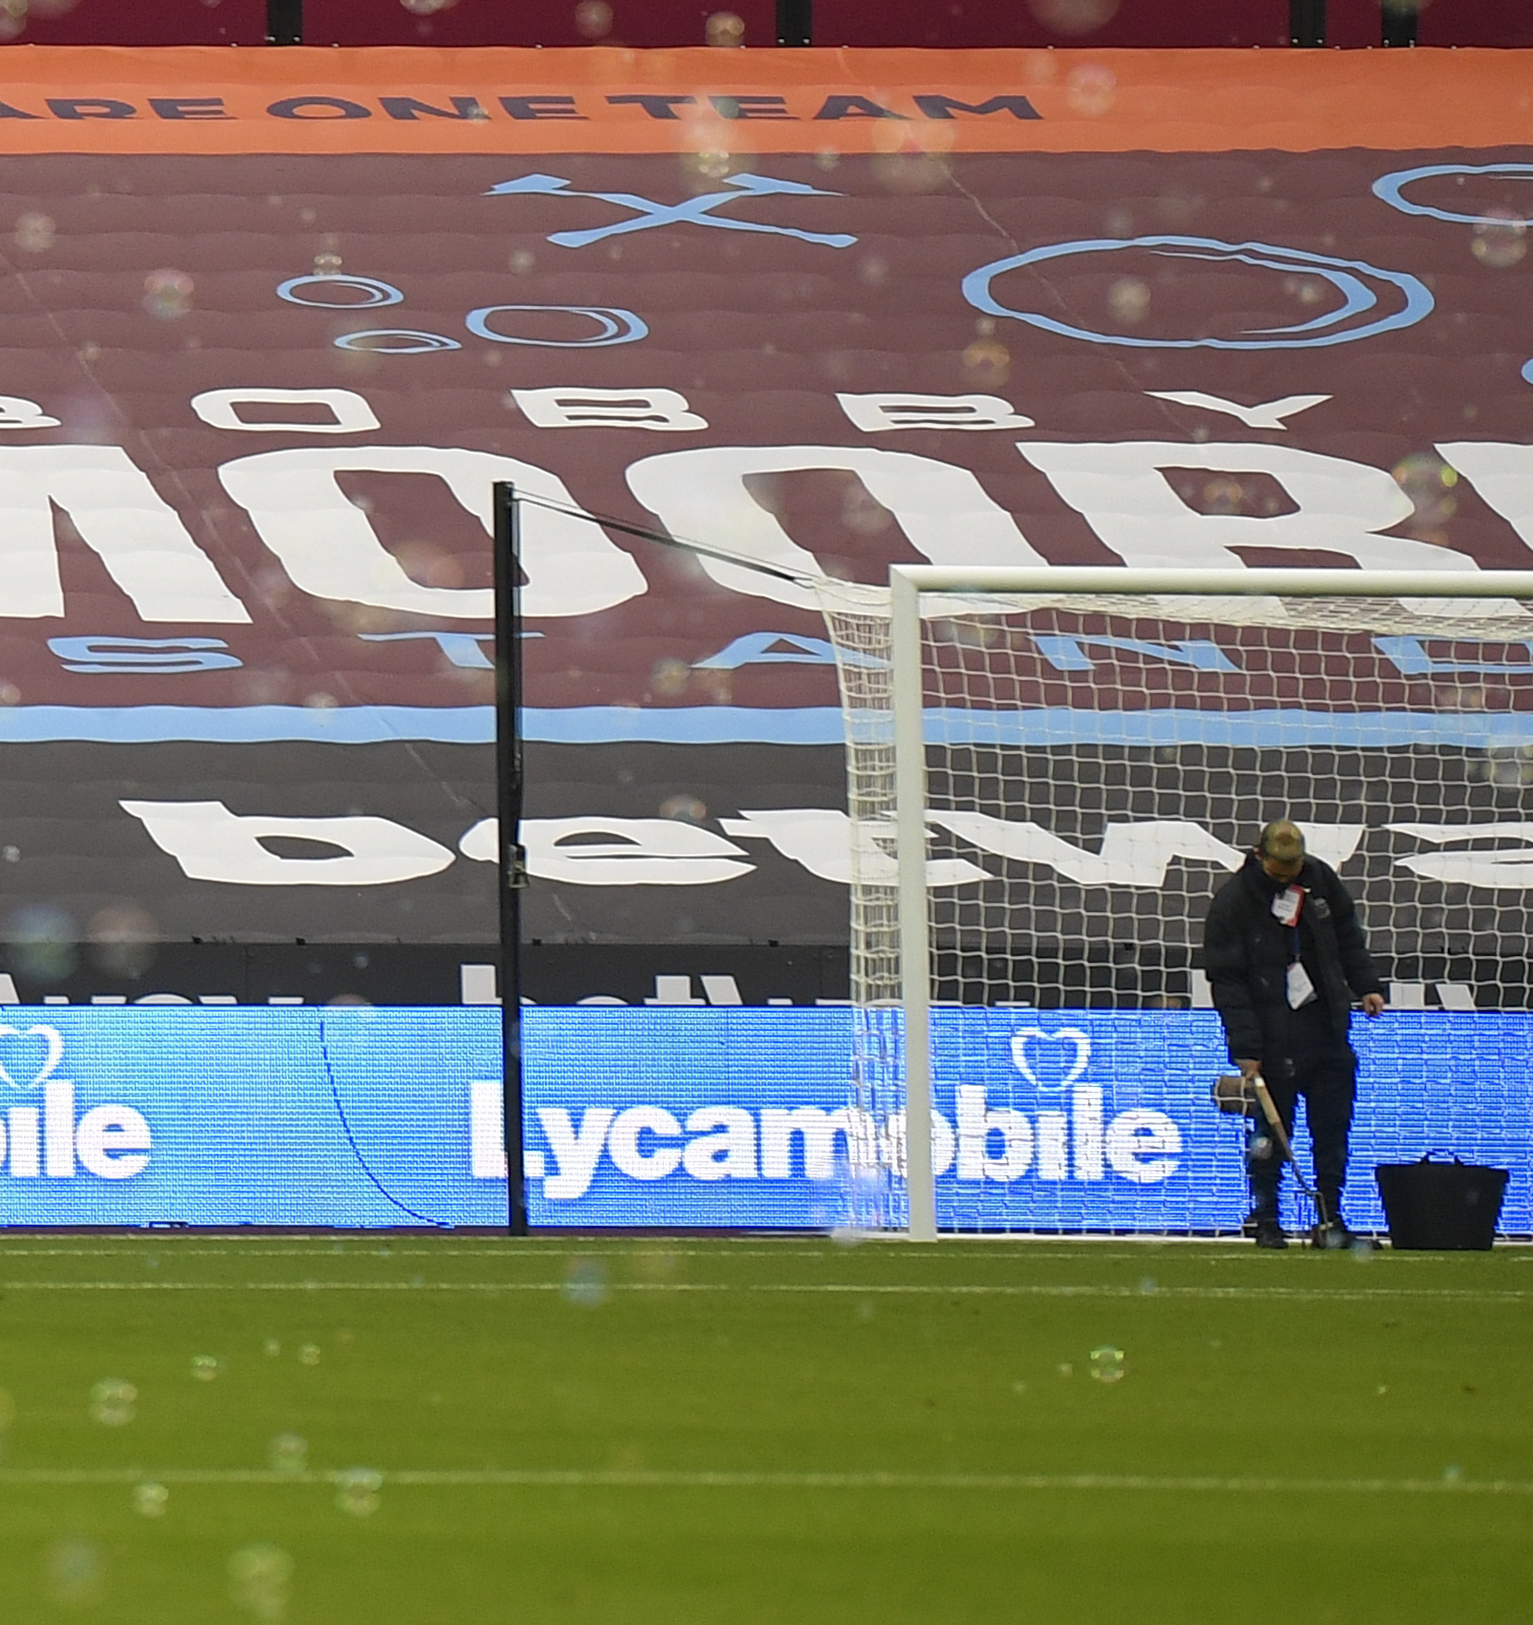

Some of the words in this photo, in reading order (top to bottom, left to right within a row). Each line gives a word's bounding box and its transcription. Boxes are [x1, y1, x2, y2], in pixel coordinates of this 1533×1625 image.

[266, 96, 591, 121] ONE
[605, 95, 1045, 121] TEAM
[471, 1079, 1183, 1199] Lycamobile
